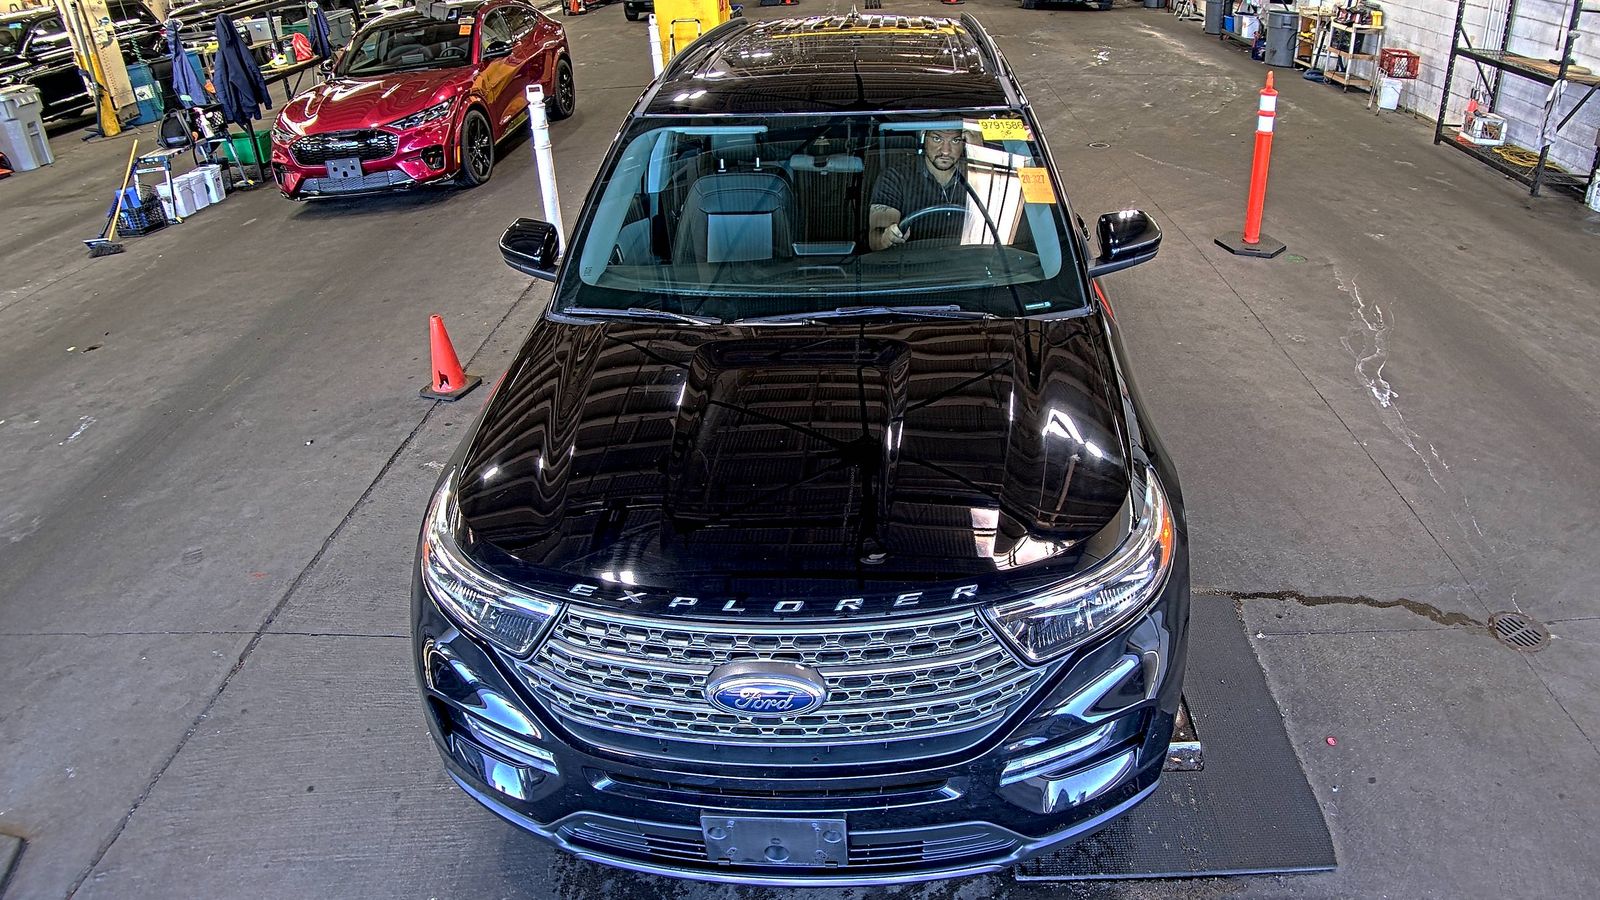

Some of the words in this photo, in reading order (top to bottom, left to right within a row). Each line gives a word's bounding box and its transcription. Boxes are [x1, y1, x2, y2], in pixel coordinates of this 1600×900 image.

[981, 121, 1024, 130] 9791586
[569, 583, 979, 613] EXPLORER
[734, 687, 795, 710] Ford
